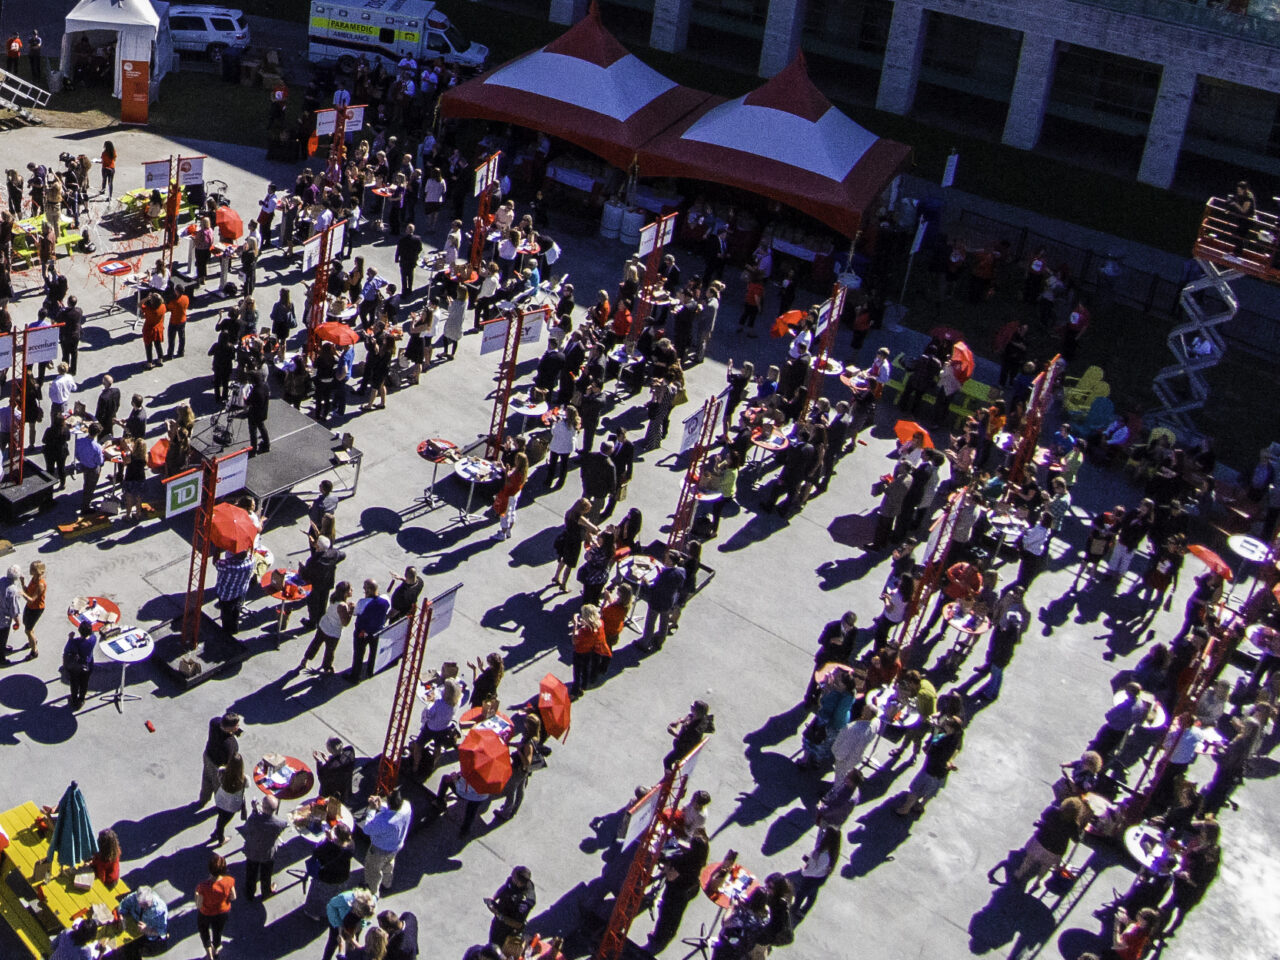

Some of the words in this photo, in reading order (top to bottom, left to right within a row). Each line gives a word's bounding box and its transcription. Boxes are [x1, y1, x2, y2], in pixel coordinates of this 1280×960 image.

[331, 20, 374, 34] PARAMEDIC
[28, 339, 57, 351] accenture
[174, 484, 195, 504] TD
